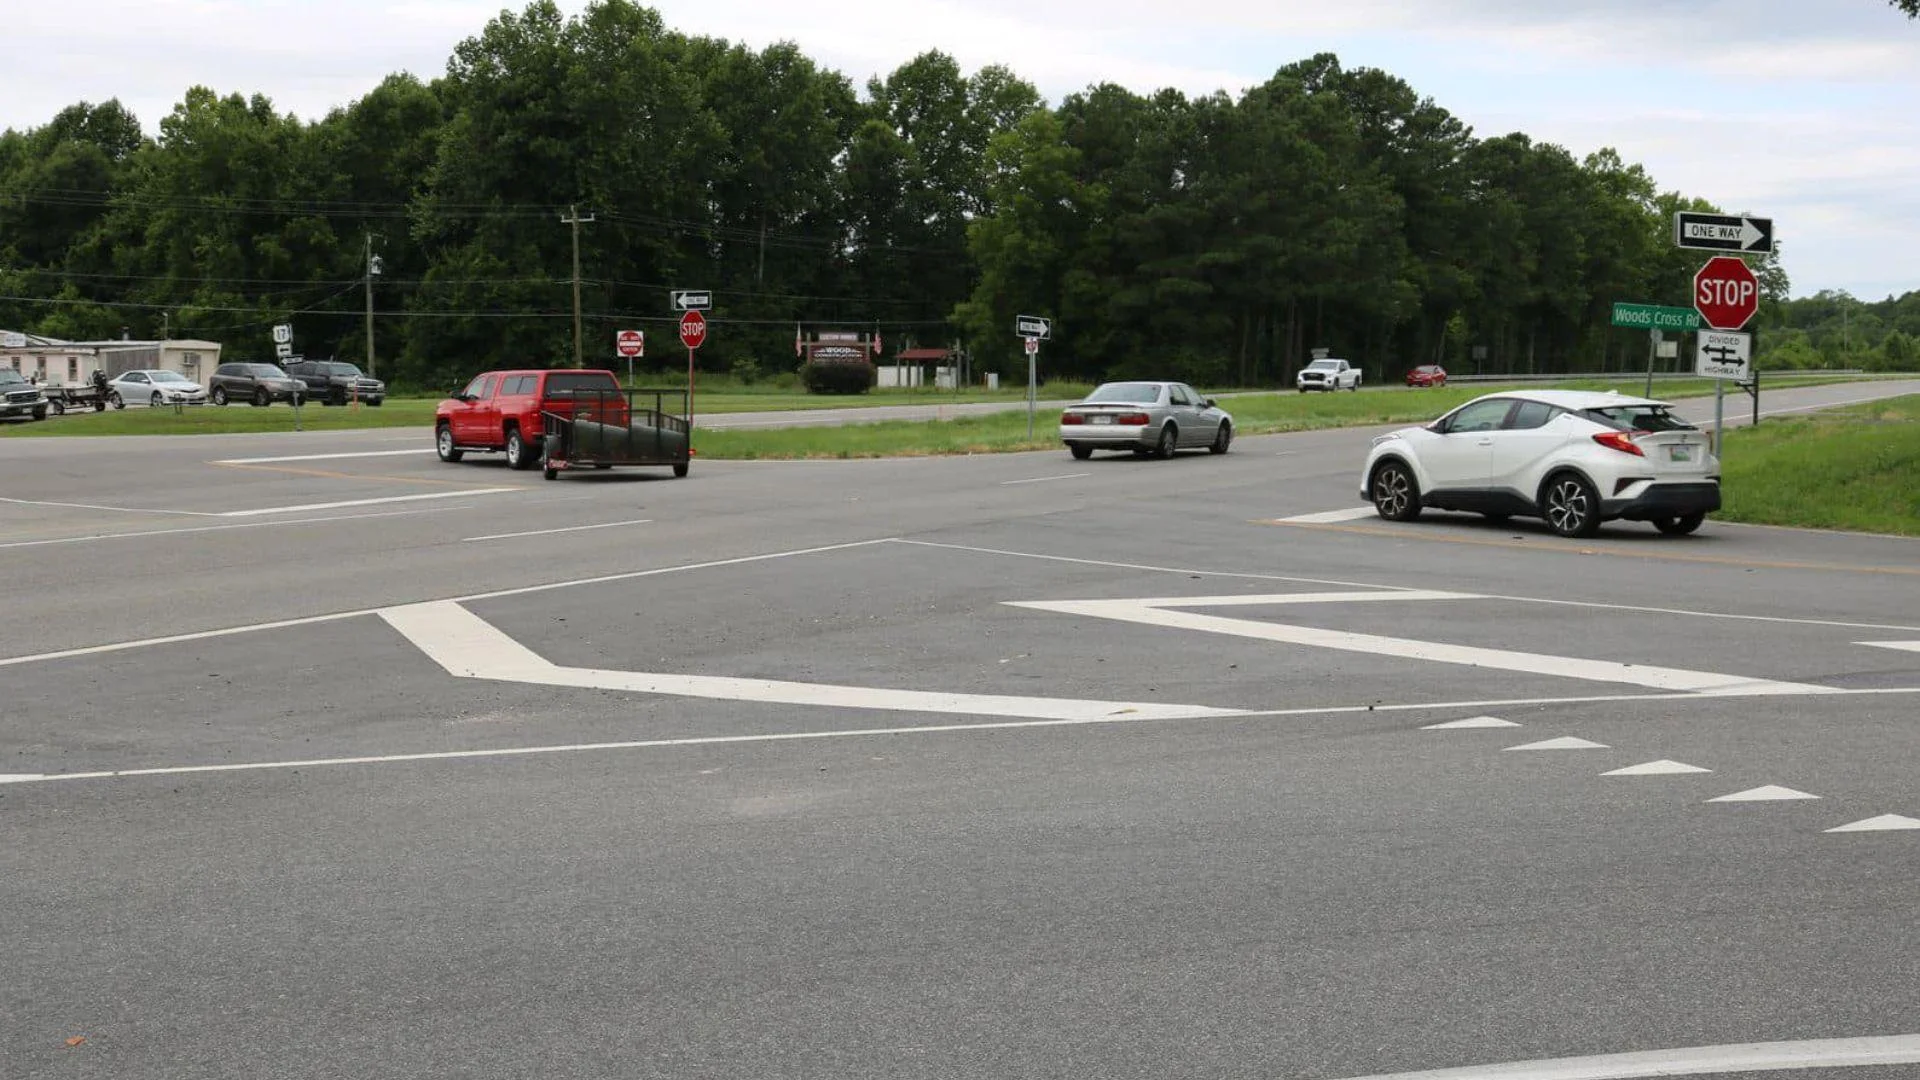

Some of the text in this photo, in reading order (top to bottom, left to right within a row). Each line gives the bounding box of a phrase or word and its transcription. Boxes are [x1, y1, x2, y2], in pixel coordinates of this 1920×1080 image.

[1692, 225, 1741, 238] ONE WAY
[1700, 279, 1753, 306] STOP
[1616, 308, 1699, 327] Woods Cross Rd
[277, 328, 286, 340] 17
[683, 322, 704, 336] STOP
[1709, 335, 1740, 345] DIVIDED
[1704, 366, 1741, 375] HIGHWAY
